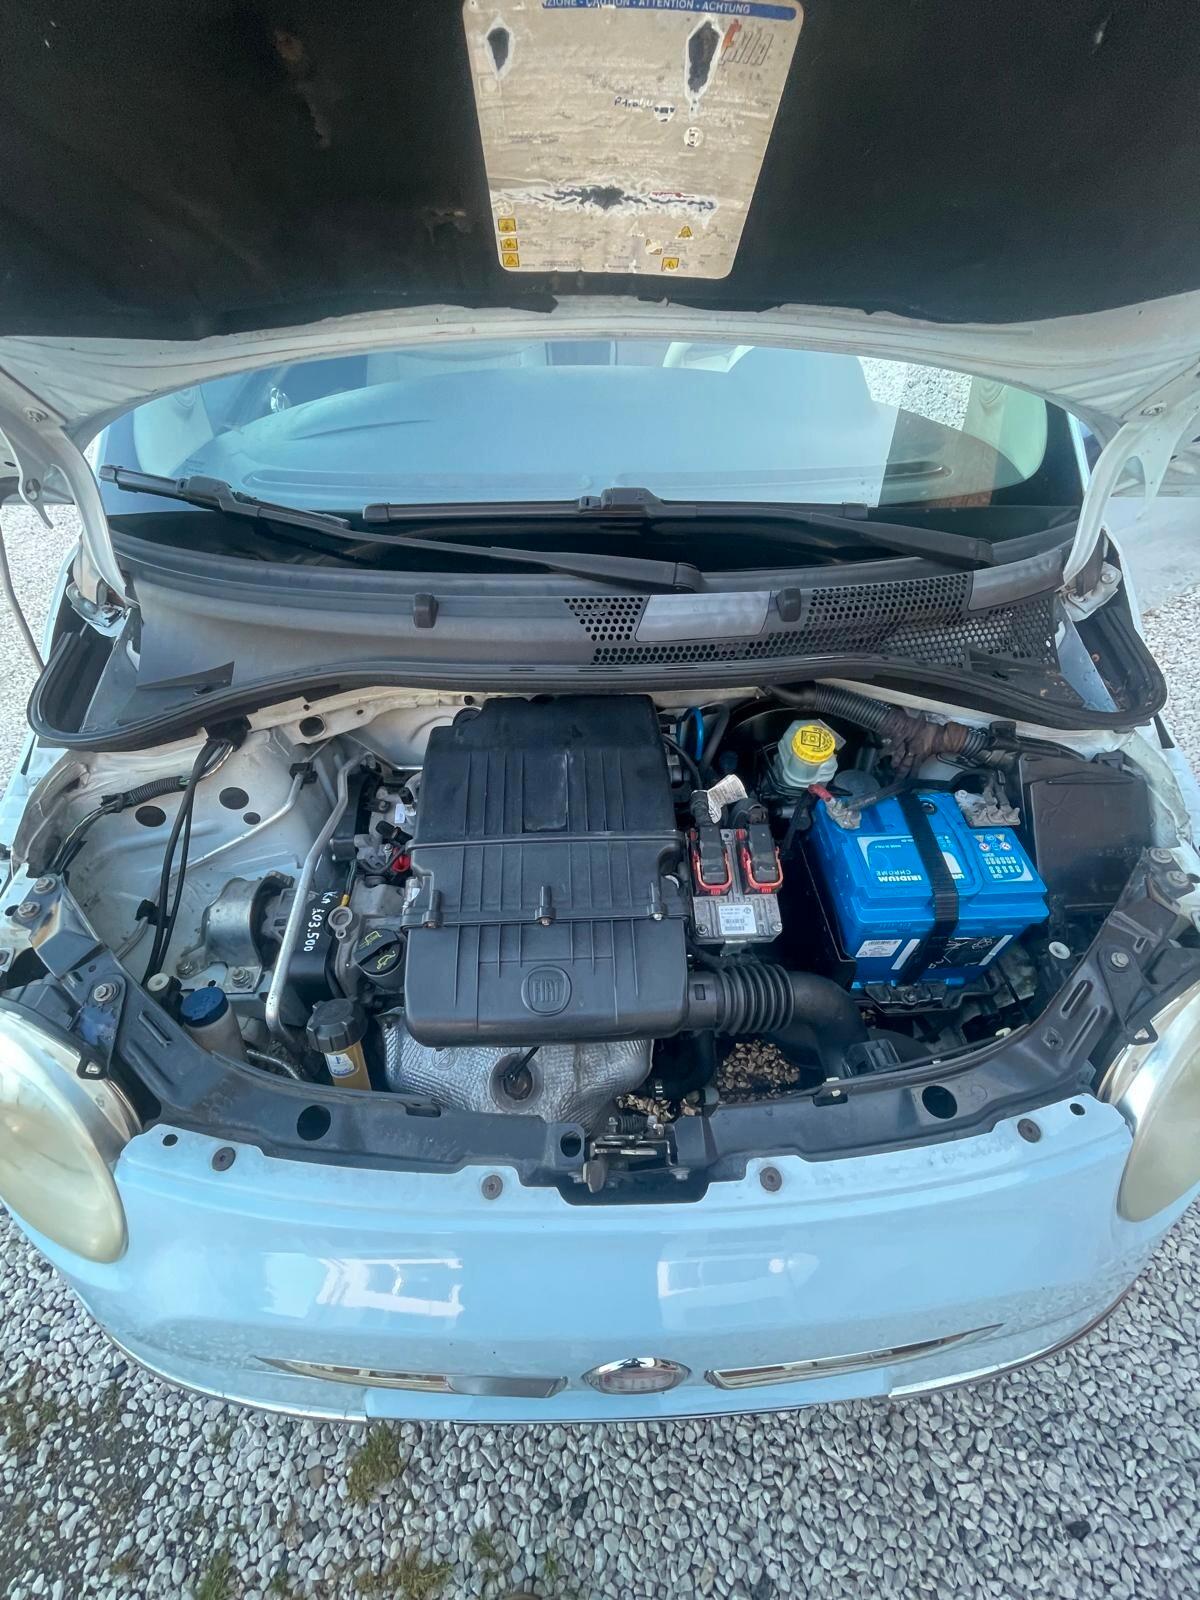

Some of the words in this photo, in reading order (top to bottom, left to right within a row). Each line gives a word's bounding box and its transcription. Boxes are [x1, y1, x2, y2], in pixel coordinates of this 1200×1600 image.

[638, 0, 694, 9] ATTENTION
[701, 1, 751, 14] ACHTUNG
[877, 874, 922, 882] IRIDIUM
[532, 979, 561, 1002] FIAT
